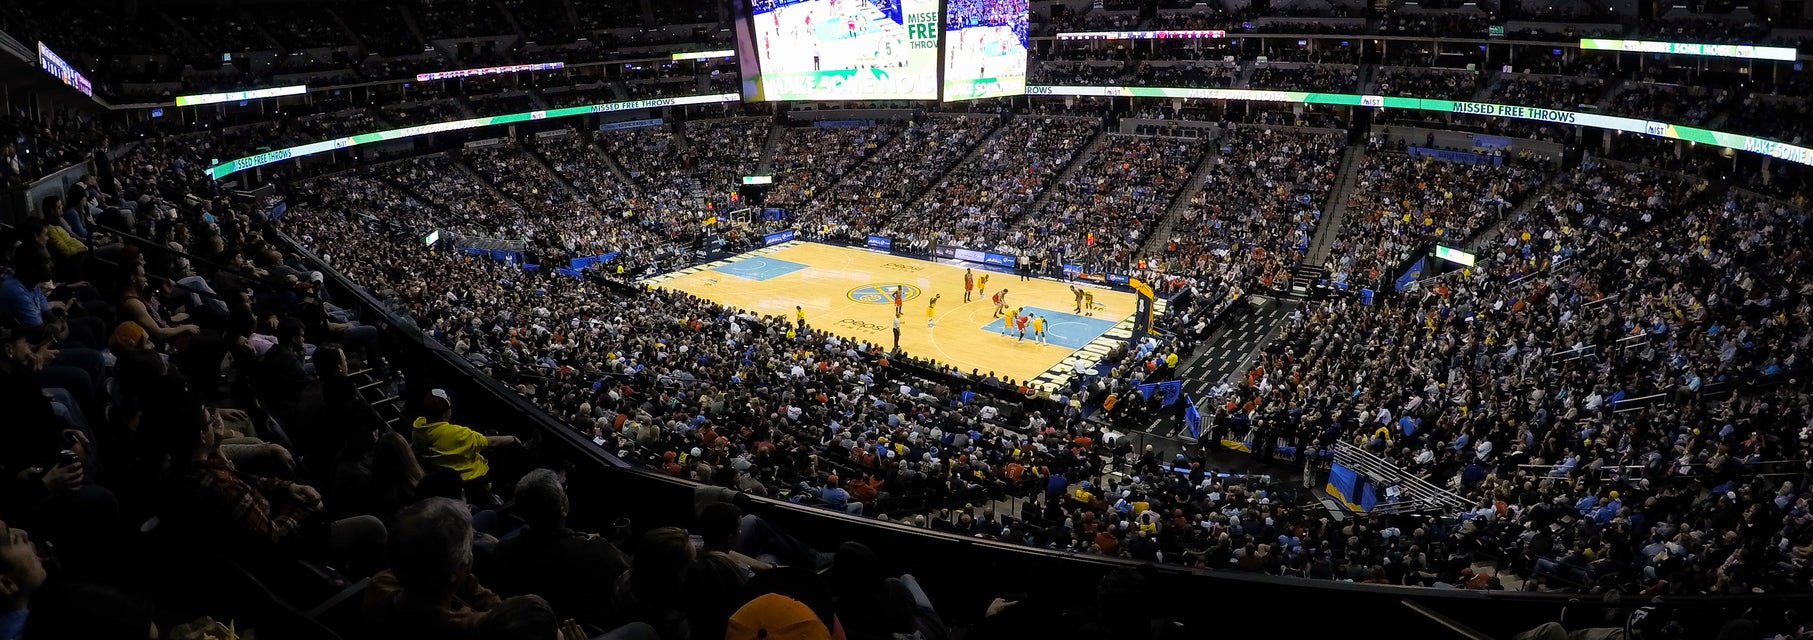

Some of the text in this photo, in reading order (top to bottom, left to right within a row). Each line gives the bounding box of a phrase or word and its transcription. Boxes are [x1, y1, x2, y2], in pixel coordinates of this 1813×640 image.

[908, 12, 937, 23] MISSE
[908, 23, 937, 39] FRE
[885, 42, 892, 55] 5
[1674, 43, 1700, 54] SOME
[1026, 86, 1053, 94] ROWS
[1188, 89, 1287, 102] MAKE SOME NOISE
[590, 98, 675, 113] MISSED FREE THROWS
[1453, 102, 1575, 123] MISSED FREE THROWS
[1744, 137, 1773, 156] MAKE
[1774, 141, 1807, 164] SOME
[254, 154, 267, 166] FREE
[268, 149, 291, 162] THROWS
[834, 318, 889, 331] pepsi
